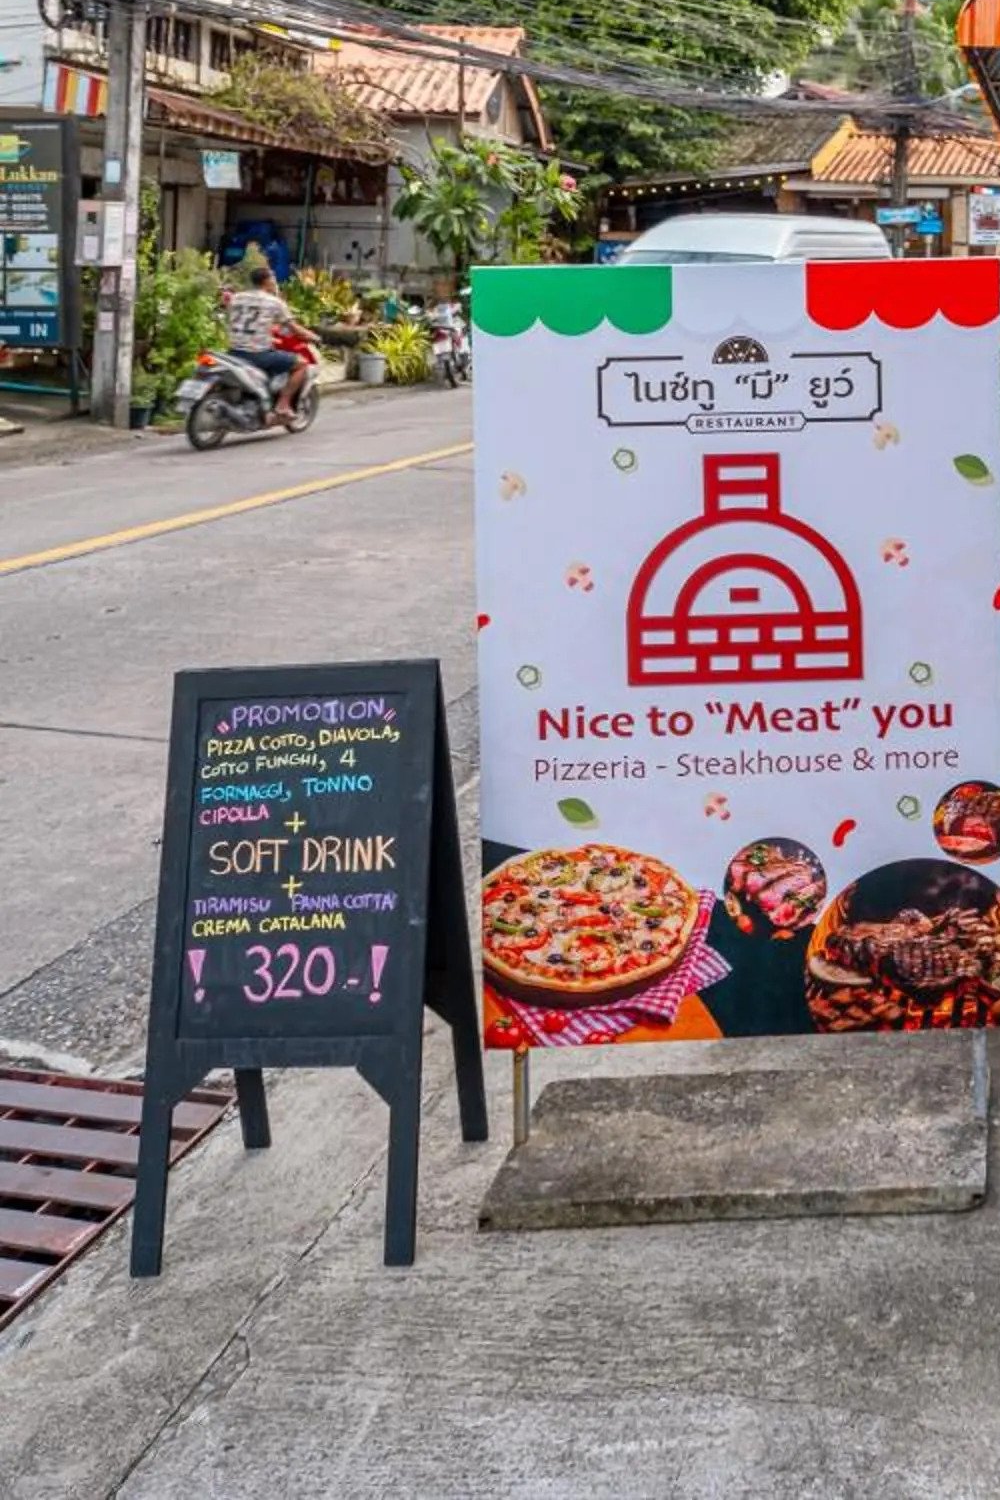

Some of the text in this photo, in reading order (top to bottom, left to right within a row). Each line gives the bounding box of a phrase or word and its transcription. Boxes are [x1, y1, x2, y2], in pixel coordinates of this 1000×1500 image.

[695, 416, 797, 430] RESTAURANT
[537, 697, 953, 741] Nice to “Meat” you
[206, 737, 255, 758] PIZZA
[318, 725, 401, 747] DIAVOLA,
[201, 748, 357, 779] COTTO FUNGHI, 4
[534, 756, 646, 783] Pizzeria
[676, 750, 843, 778] Steakhouse
[853, 747, 875, 771] &
[884, 747, 960, 771] more
[201, 775, 373, 804] FORMAGGI, TONNO
[199, 804, 270, 826] CIPOLLA
[209, 834, 396, 876] SOFT DRINK
[193, 896, 272, 915] TIRAMISU
[291, 893, 340, 912] PANNA
[191, 912, 346, 937] CREMA CATALANA
